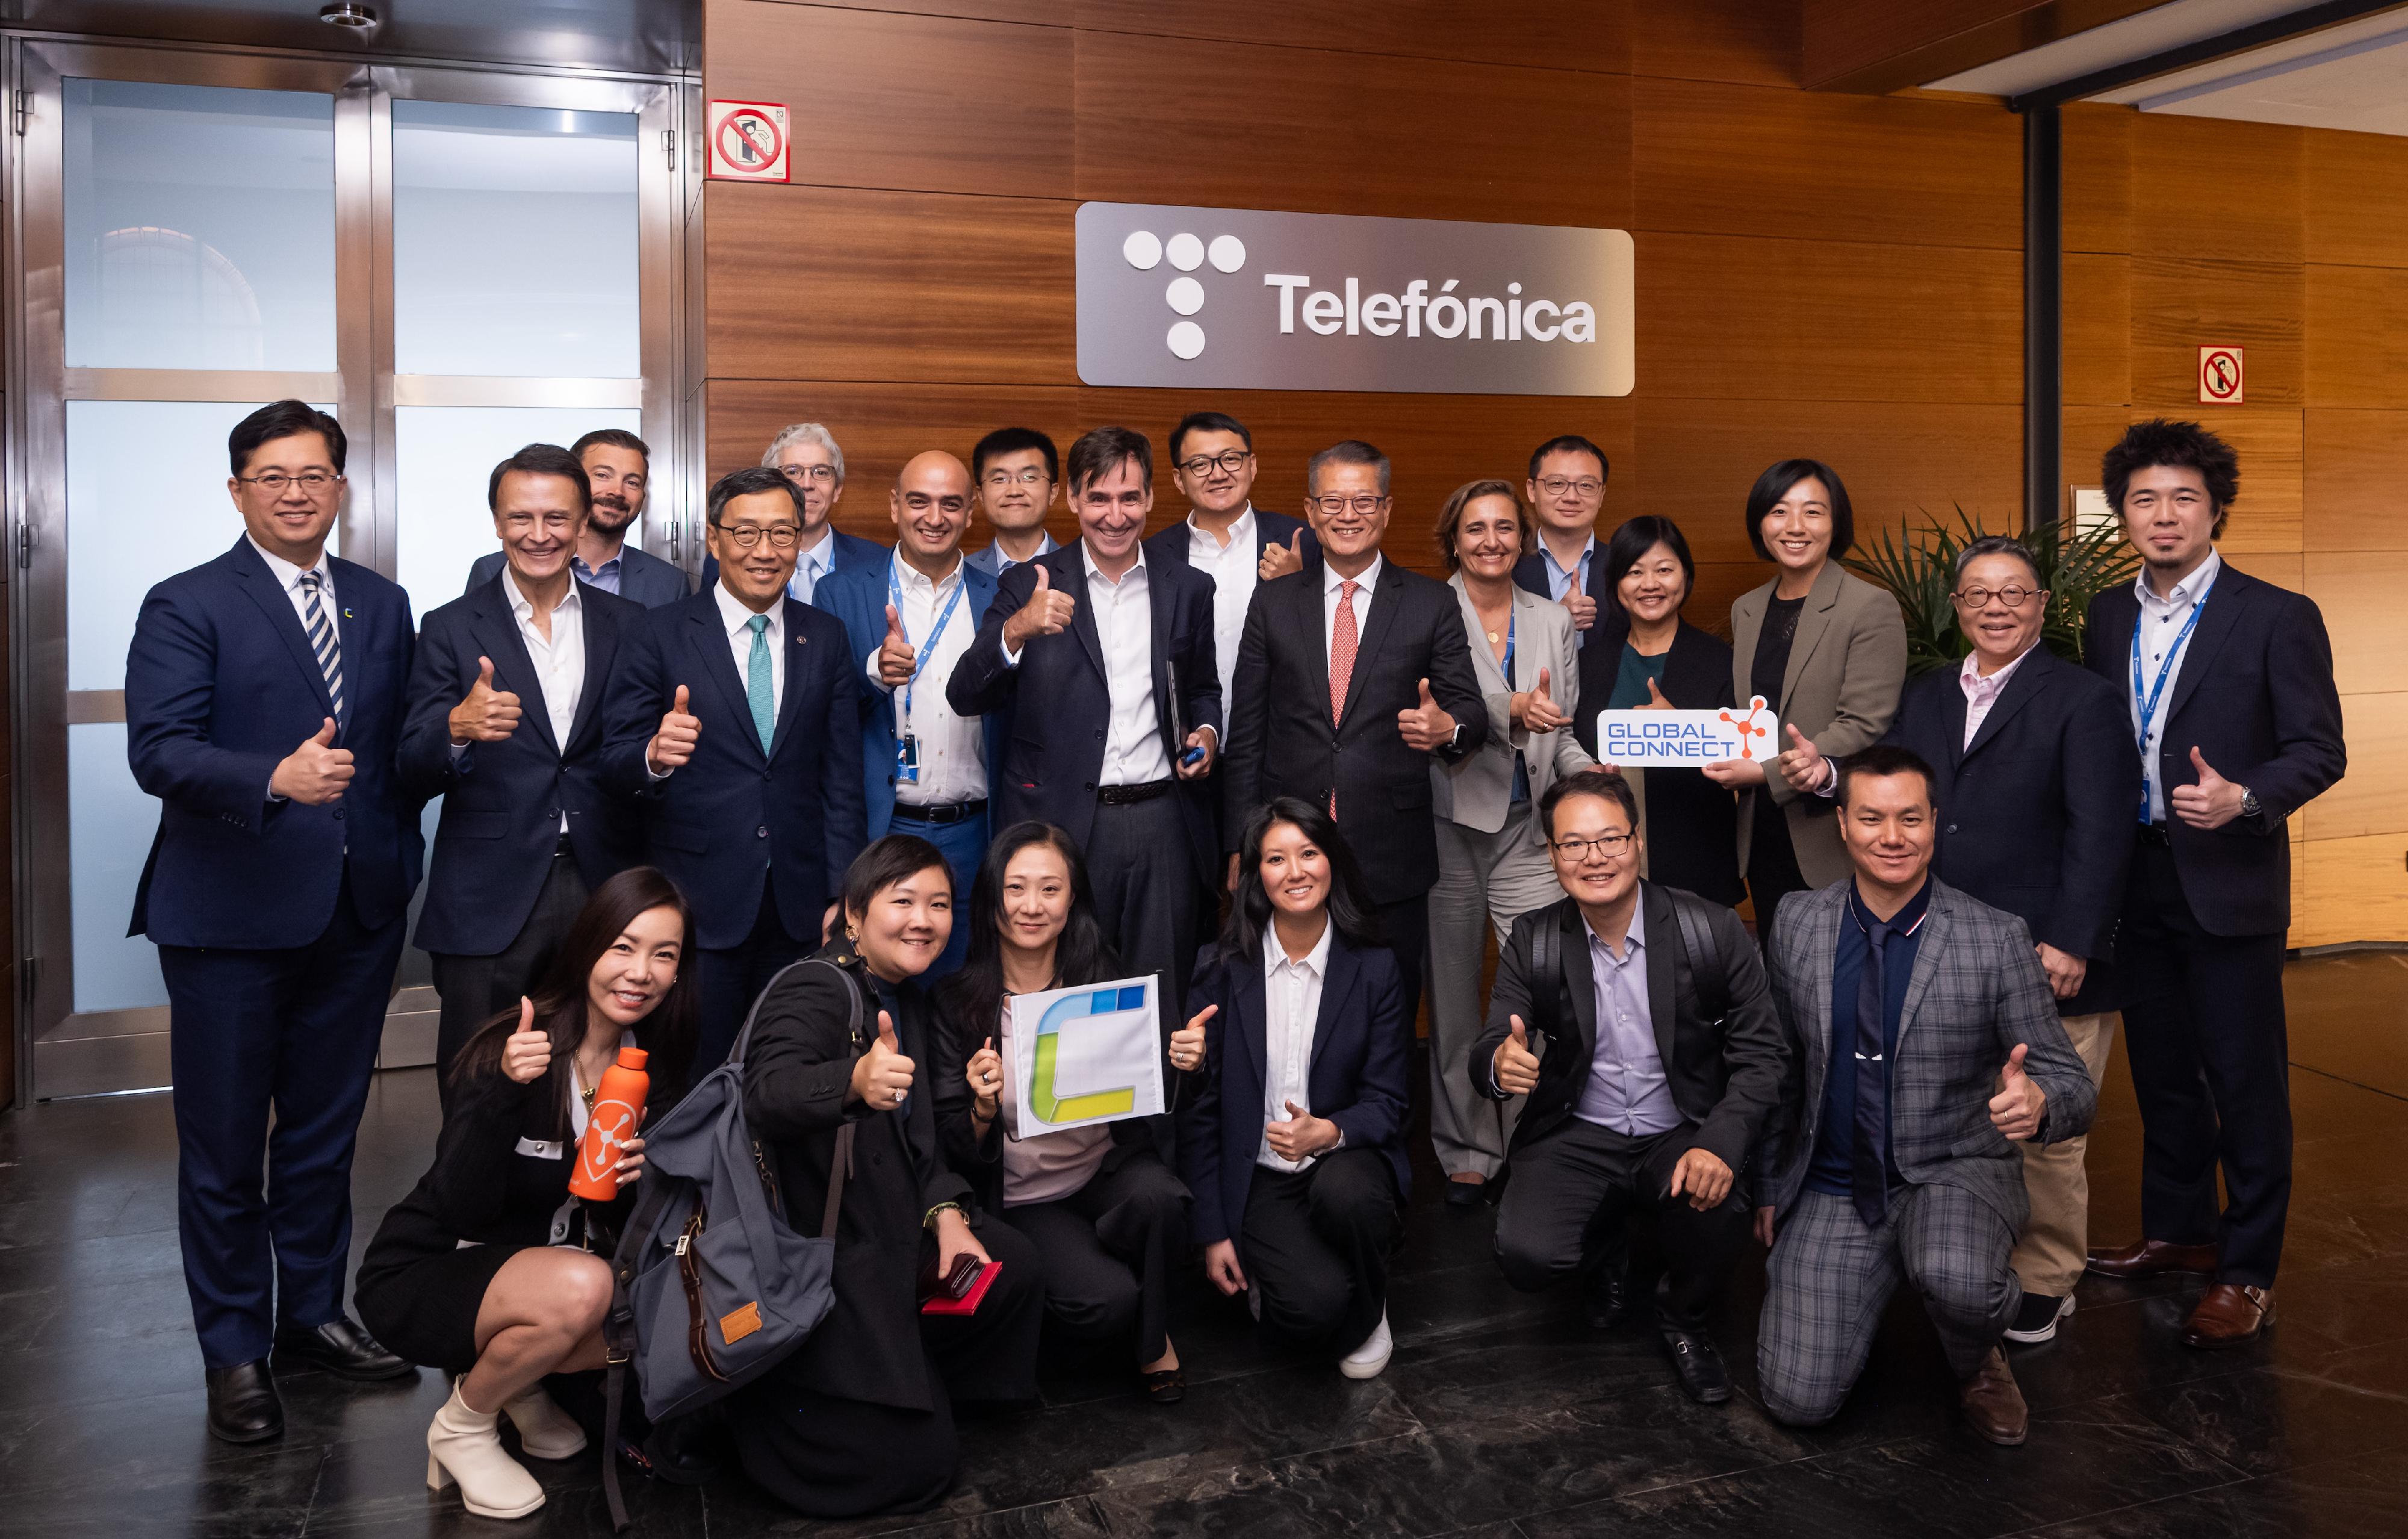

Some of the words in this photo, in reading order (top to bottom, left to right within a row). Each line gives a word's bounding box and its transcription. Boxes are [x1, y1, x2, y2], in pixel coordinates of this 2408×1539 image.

[1264, 274, 1595, 343] Telefónica
[1608, 723, 1716, 739] GLOBAL
[1608, 741, 1735, 757] CONNECT
